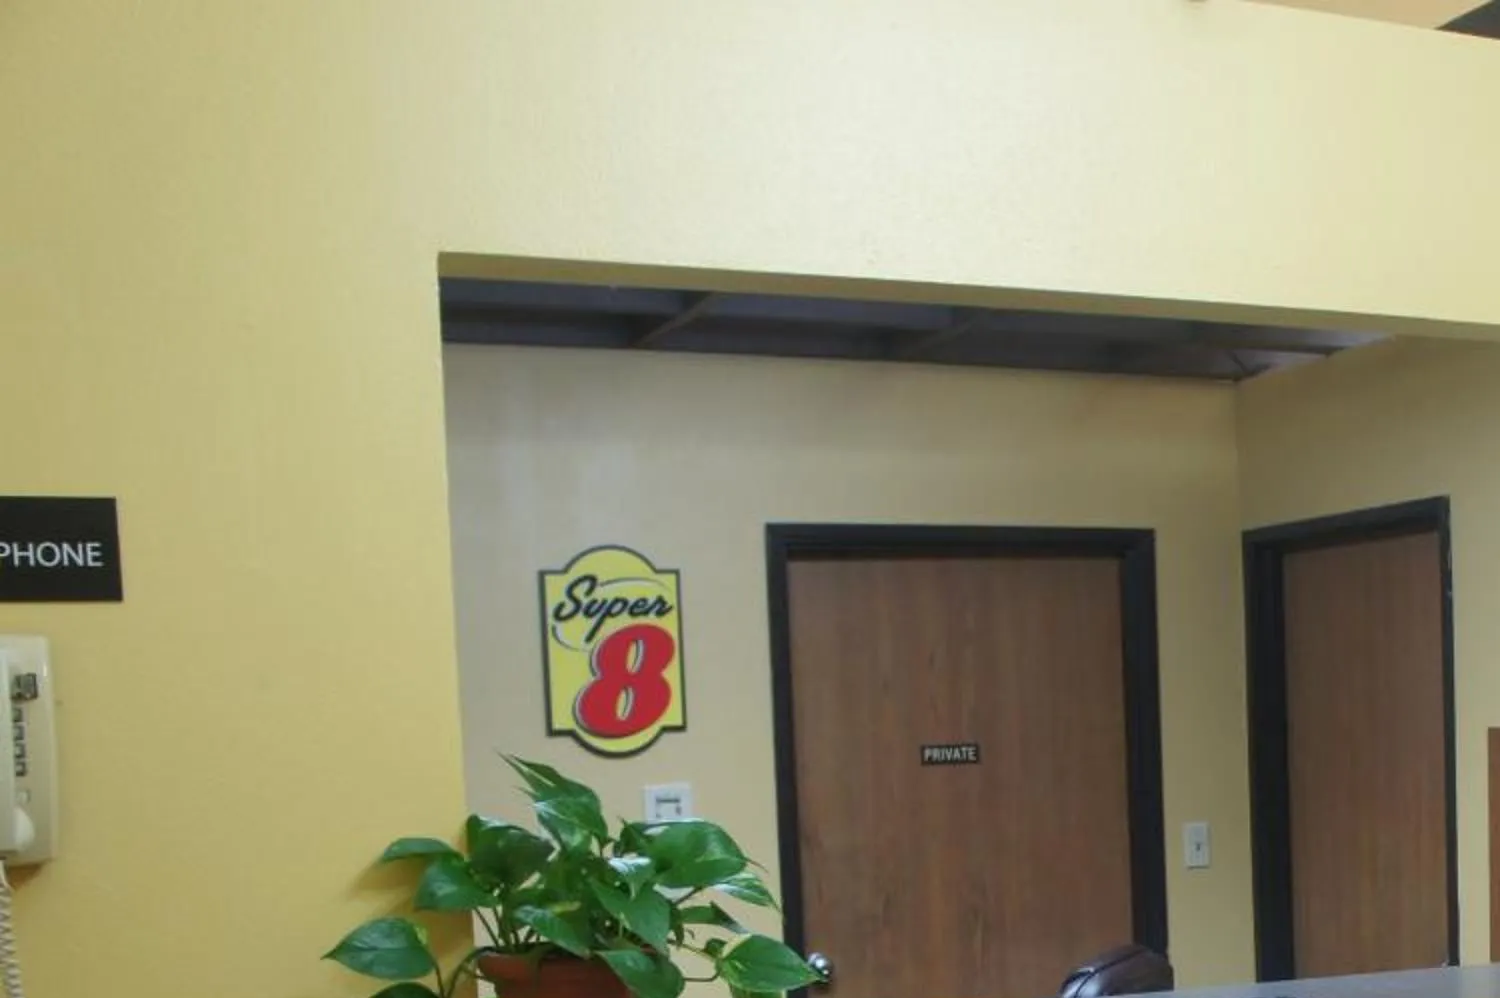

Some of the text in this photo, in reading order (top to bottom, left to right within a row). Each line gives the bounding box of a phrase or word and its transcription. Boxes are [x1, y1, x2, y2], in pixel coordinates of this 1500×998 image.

[0, 541, 104, 567] PHONE
[552, 574, 674, 645] Super
[572, 622, 676, 739] 8
[923, 746, 977, 762] PRIVATE
